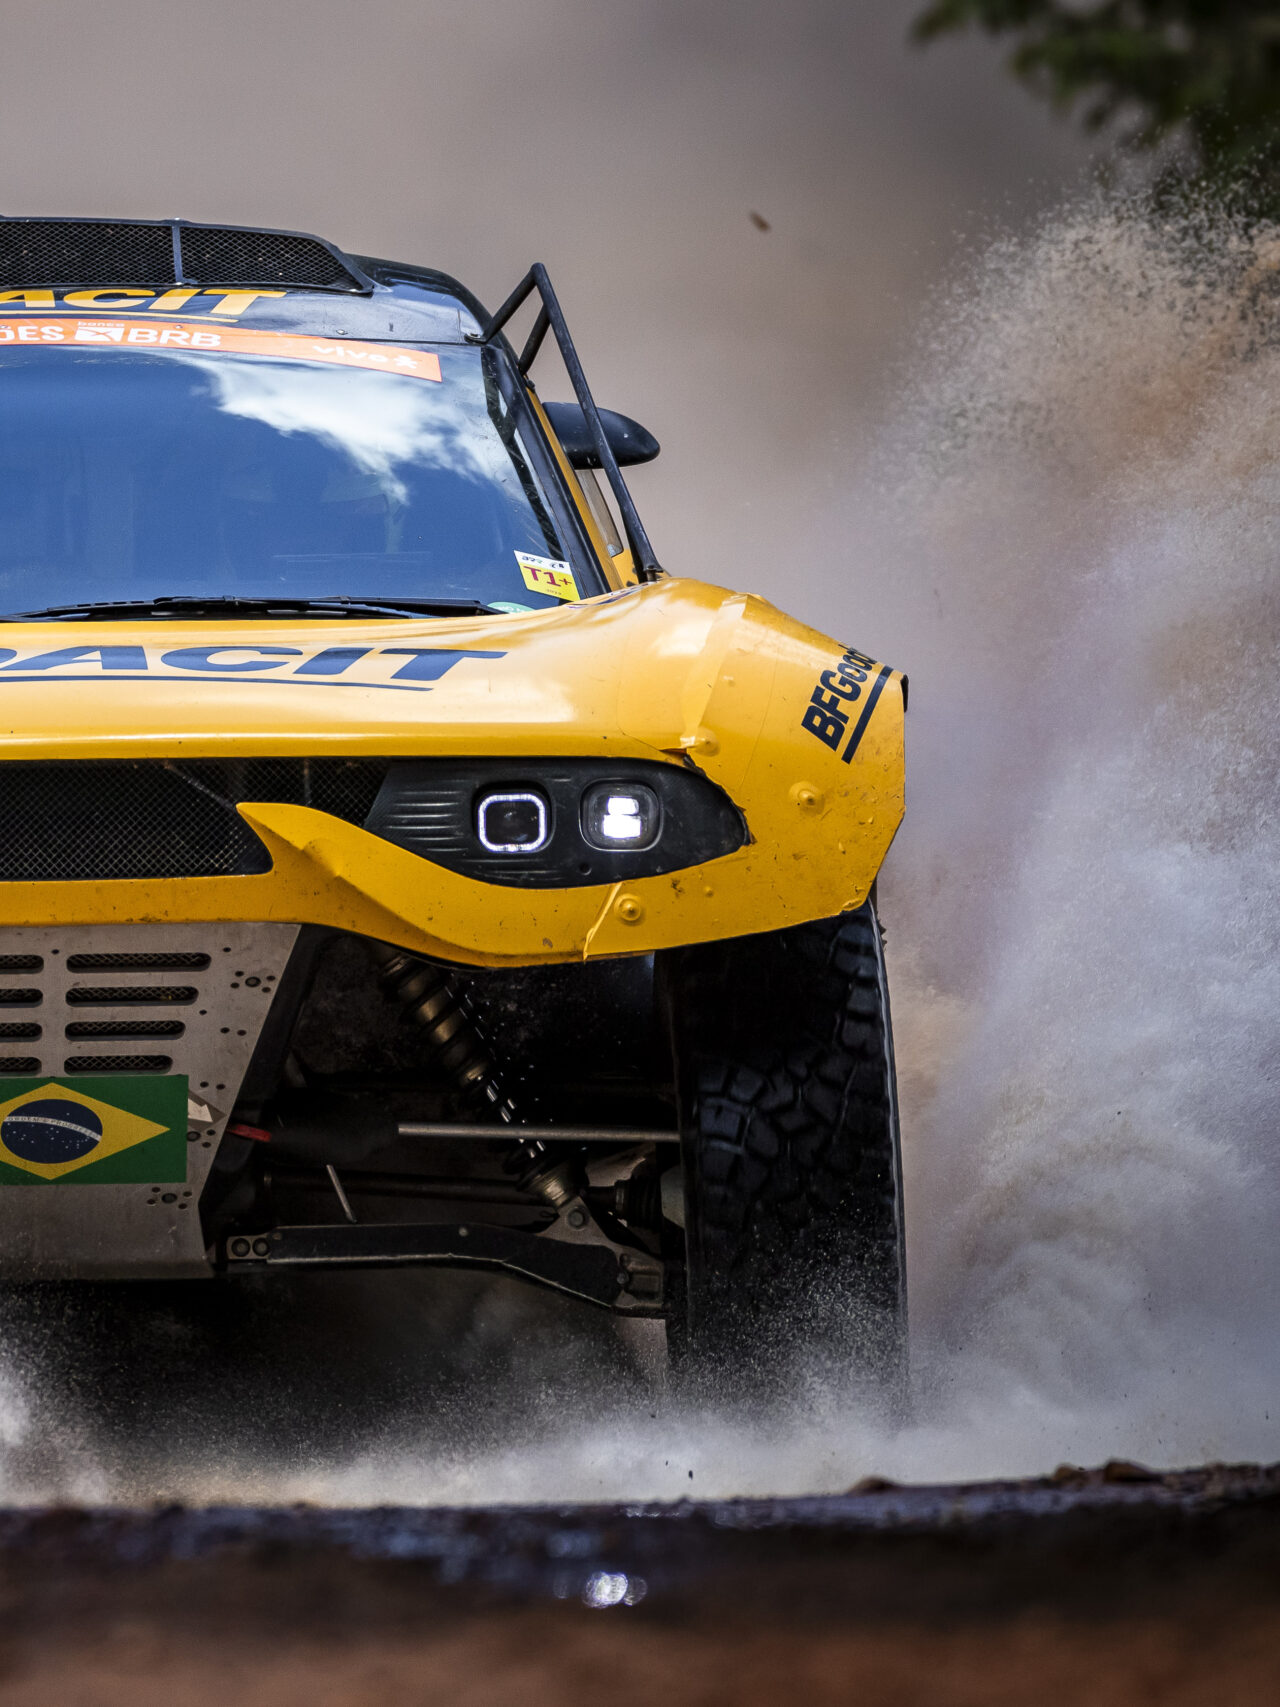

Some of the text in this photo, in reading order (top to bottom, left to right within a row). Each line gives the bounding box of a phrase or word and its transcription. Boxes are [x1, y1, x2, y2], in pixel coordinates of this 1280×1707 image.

[127, 327, 222, 347] BRB
[312, 345, 389, 363] vivo
[523, 565, 573, 588] T1+
